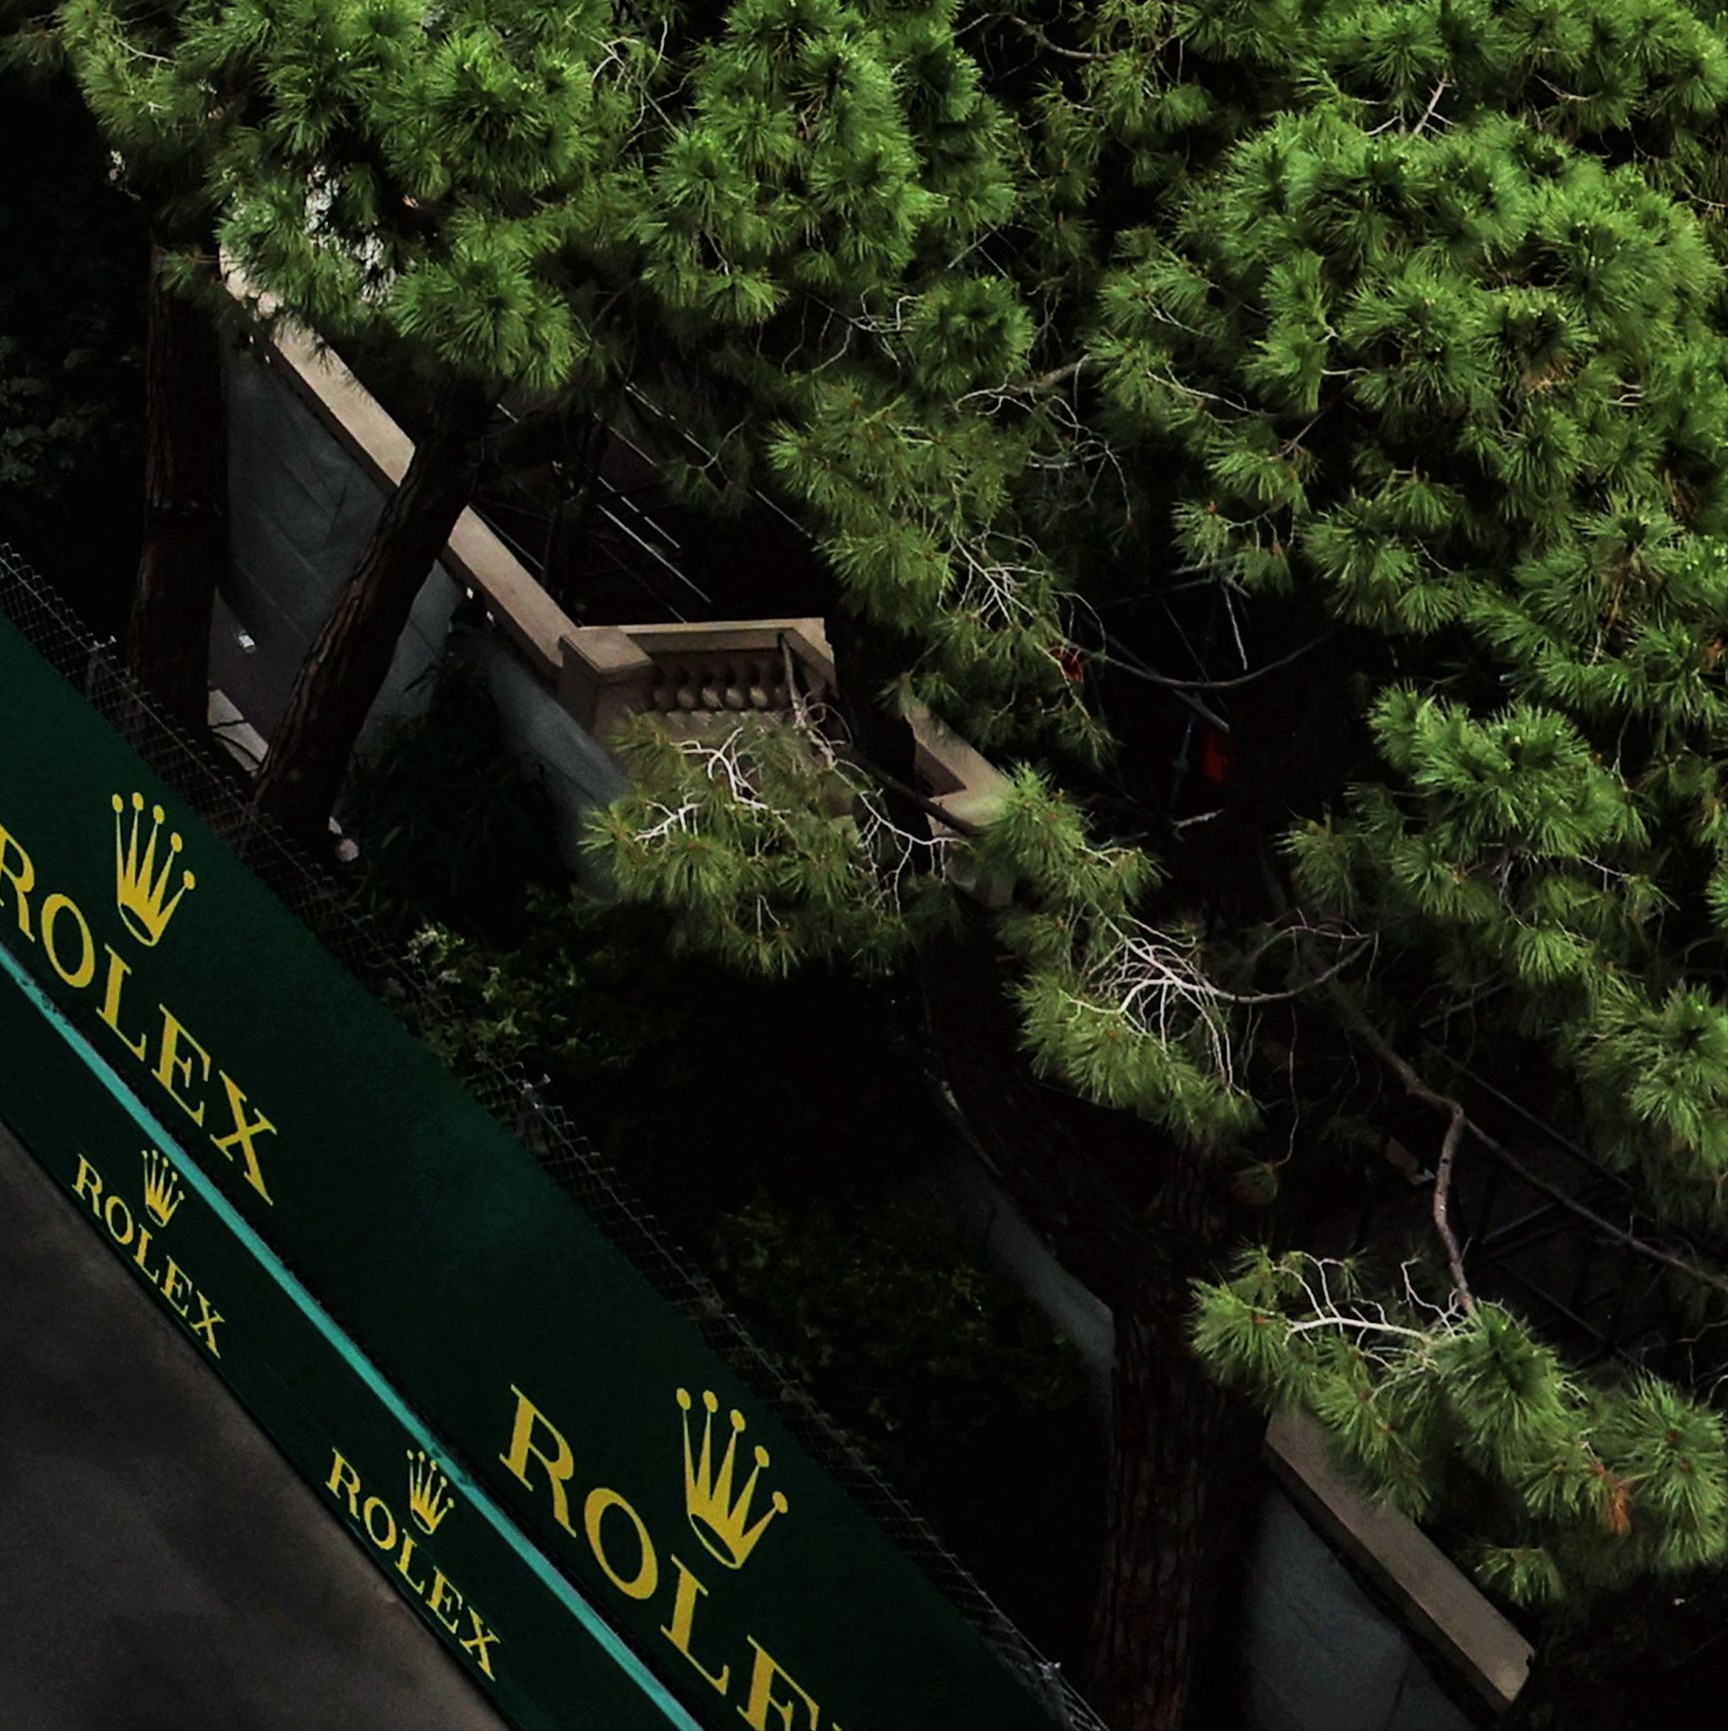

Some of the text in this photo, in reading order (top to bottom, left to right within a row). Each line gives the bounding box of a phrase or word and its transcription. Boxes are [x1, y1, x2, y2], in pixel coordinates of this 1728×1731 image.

[72, 1153, 225, 1360] ROLEX
[326, 1446, 501, 1683] ROLEX
[499, 1383, 844, 1731] ROLE
